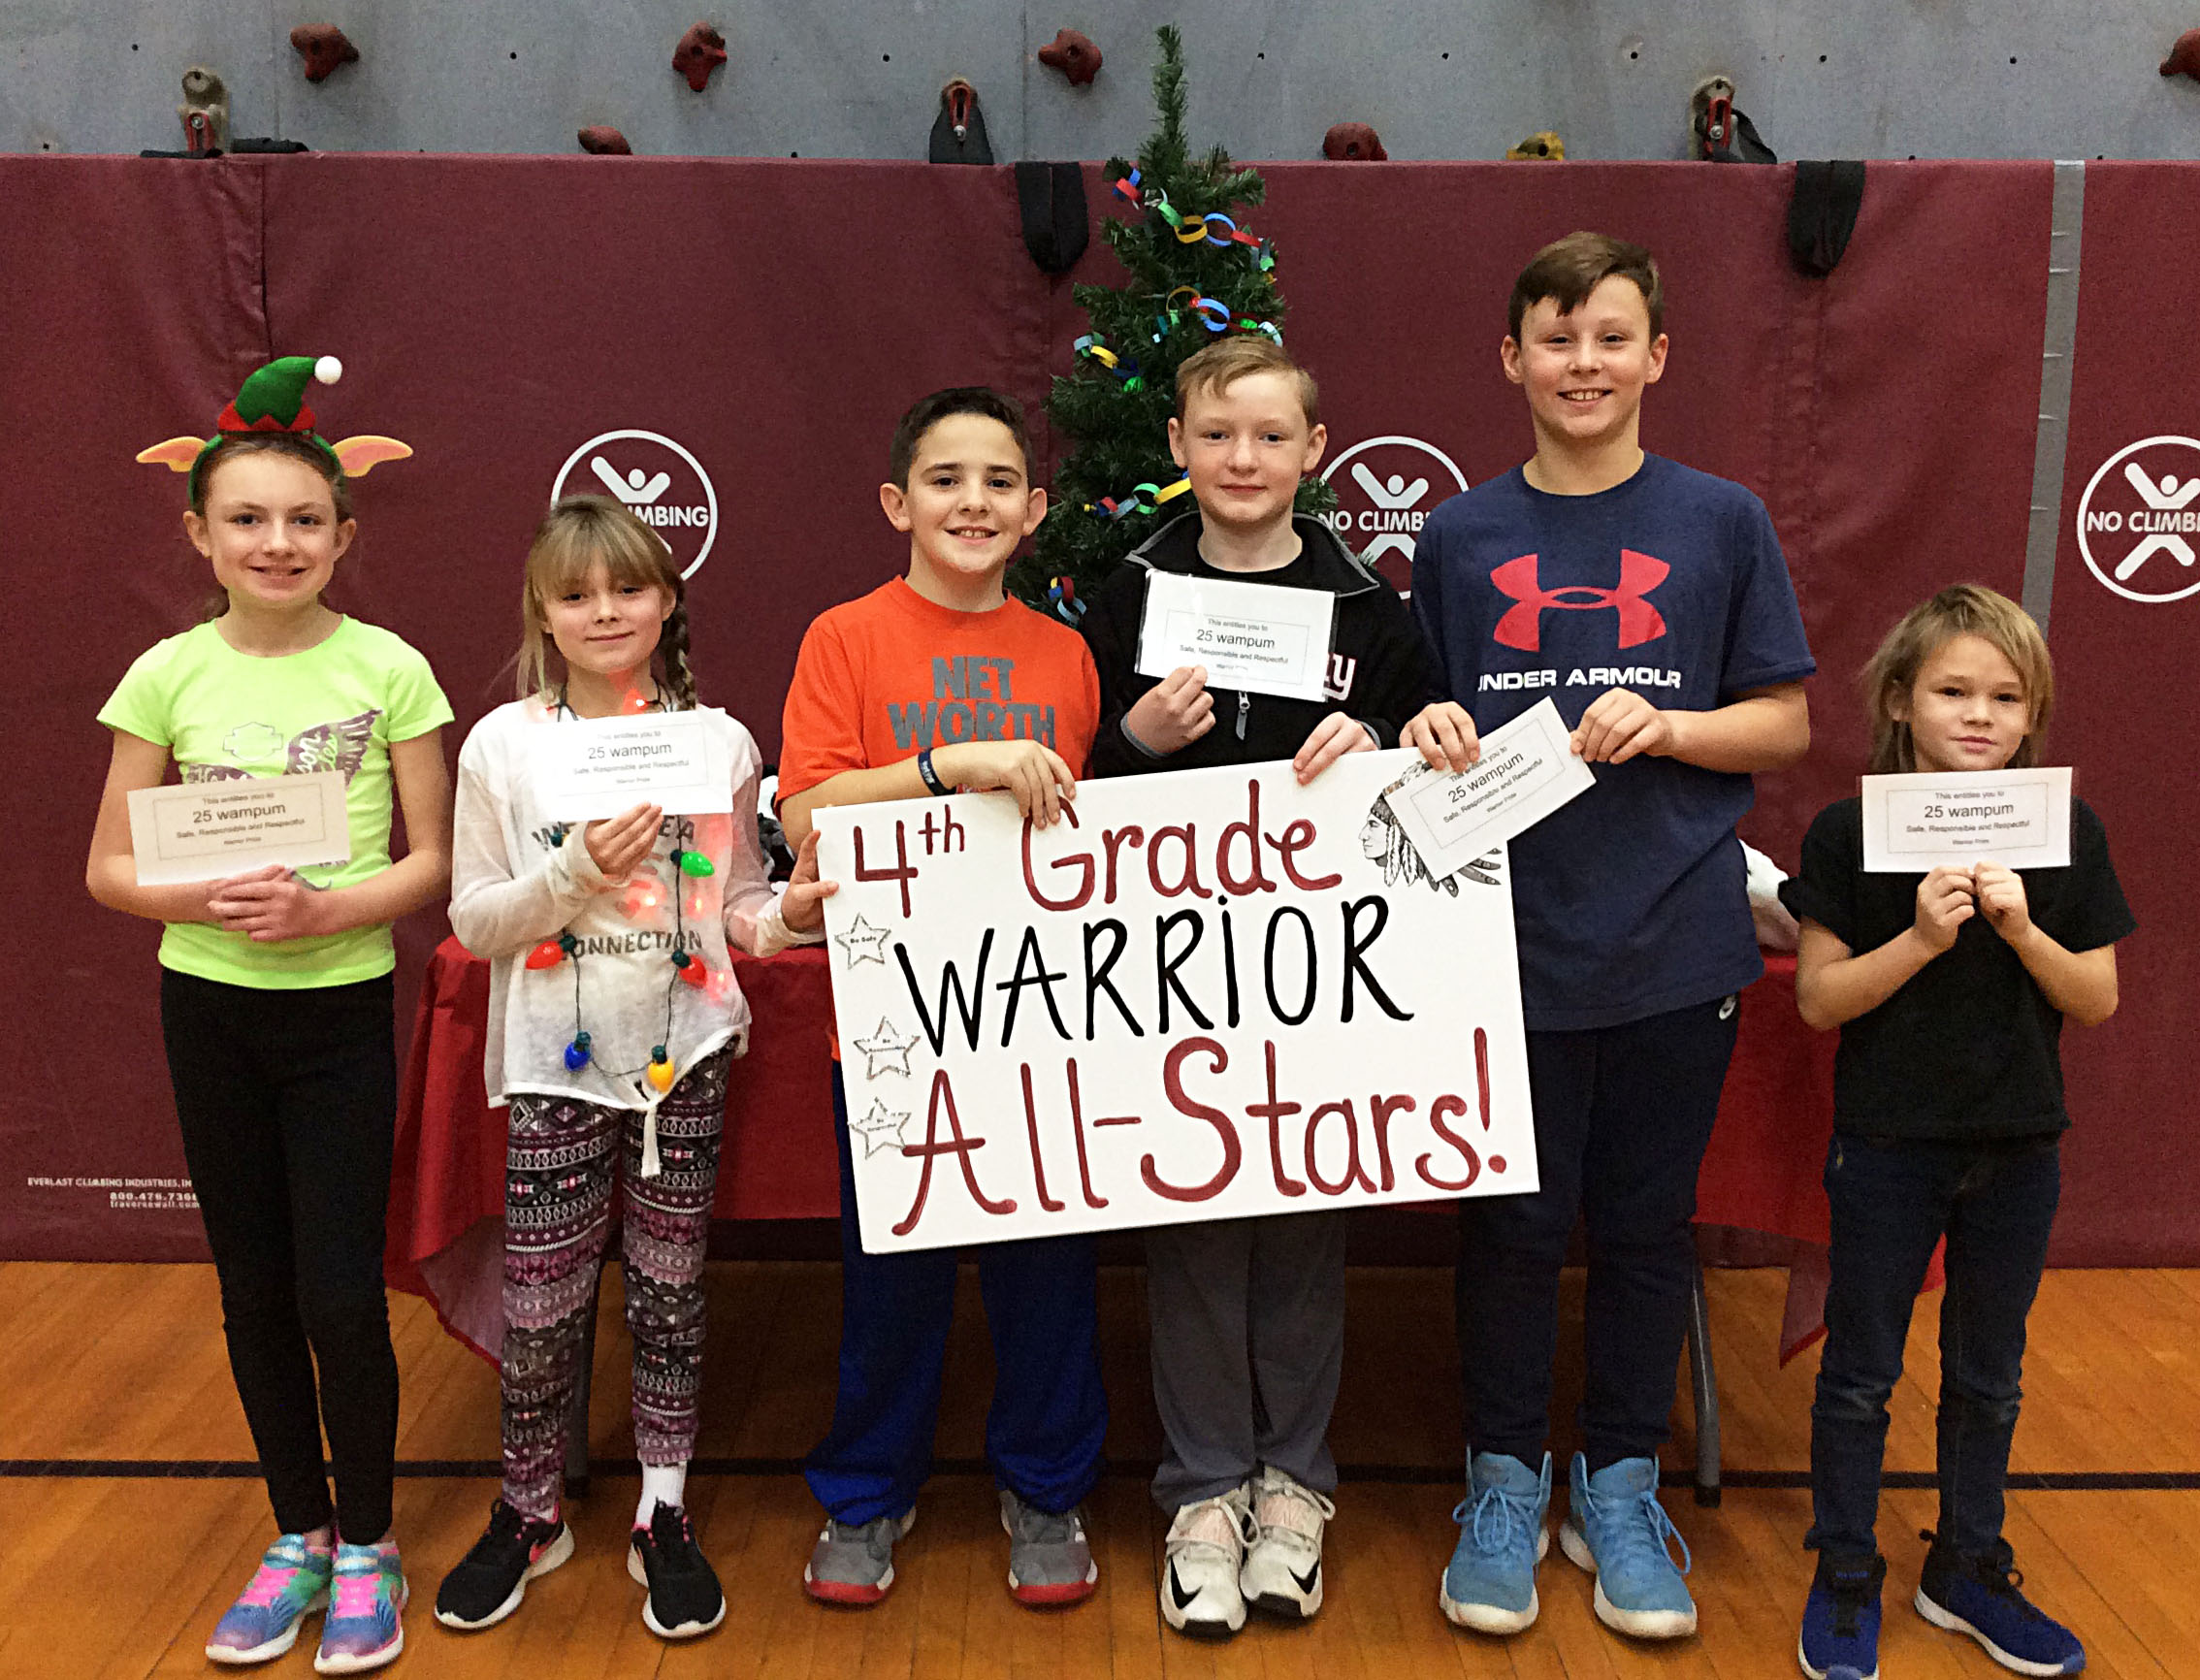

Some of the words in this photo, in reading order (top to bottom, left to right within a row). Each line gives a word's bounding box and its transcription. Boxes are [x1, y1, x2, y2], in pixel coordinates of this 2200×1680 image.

[628, 505, 709, 527] MBING
[1318, 510, 1352, 532] NO
[2087, 511, 2123, 533] NO
[1196, 629, 1213, 642] 25
[1216, 633, 1276, 649] wampum
[932, 656, 1015, 700] NET
[1565, 666, 1681, 689] ARMOUR
[887, 701, 1056, 751] WORTH
[588, 747, 605, 759] 25
[609, 743, 672, 758] wampum
[1488, 752, 1501, 762] you
[1447, 785, 1467, 803] 25
[1467, 753, 1524, 792] wampum
[1500, 779, 1512, 791] and
[192, 809, 212, 824] 25
[216, 804, 286, 821] wampum
[1924, 805, 1944, 819] 25
[1948, 803, 2014, 819] wampum
[853, 802, 965, 919] 4th
[1020, 779, 1343, 912] Grade
[563, 929, 703, 959] ONNECTION
[892, 1027, 1508, 1237] All-Stars!
[27, 1177, 74, 1186] EVERLAST
[75, 1178, 123, 1187] CLIMBING
